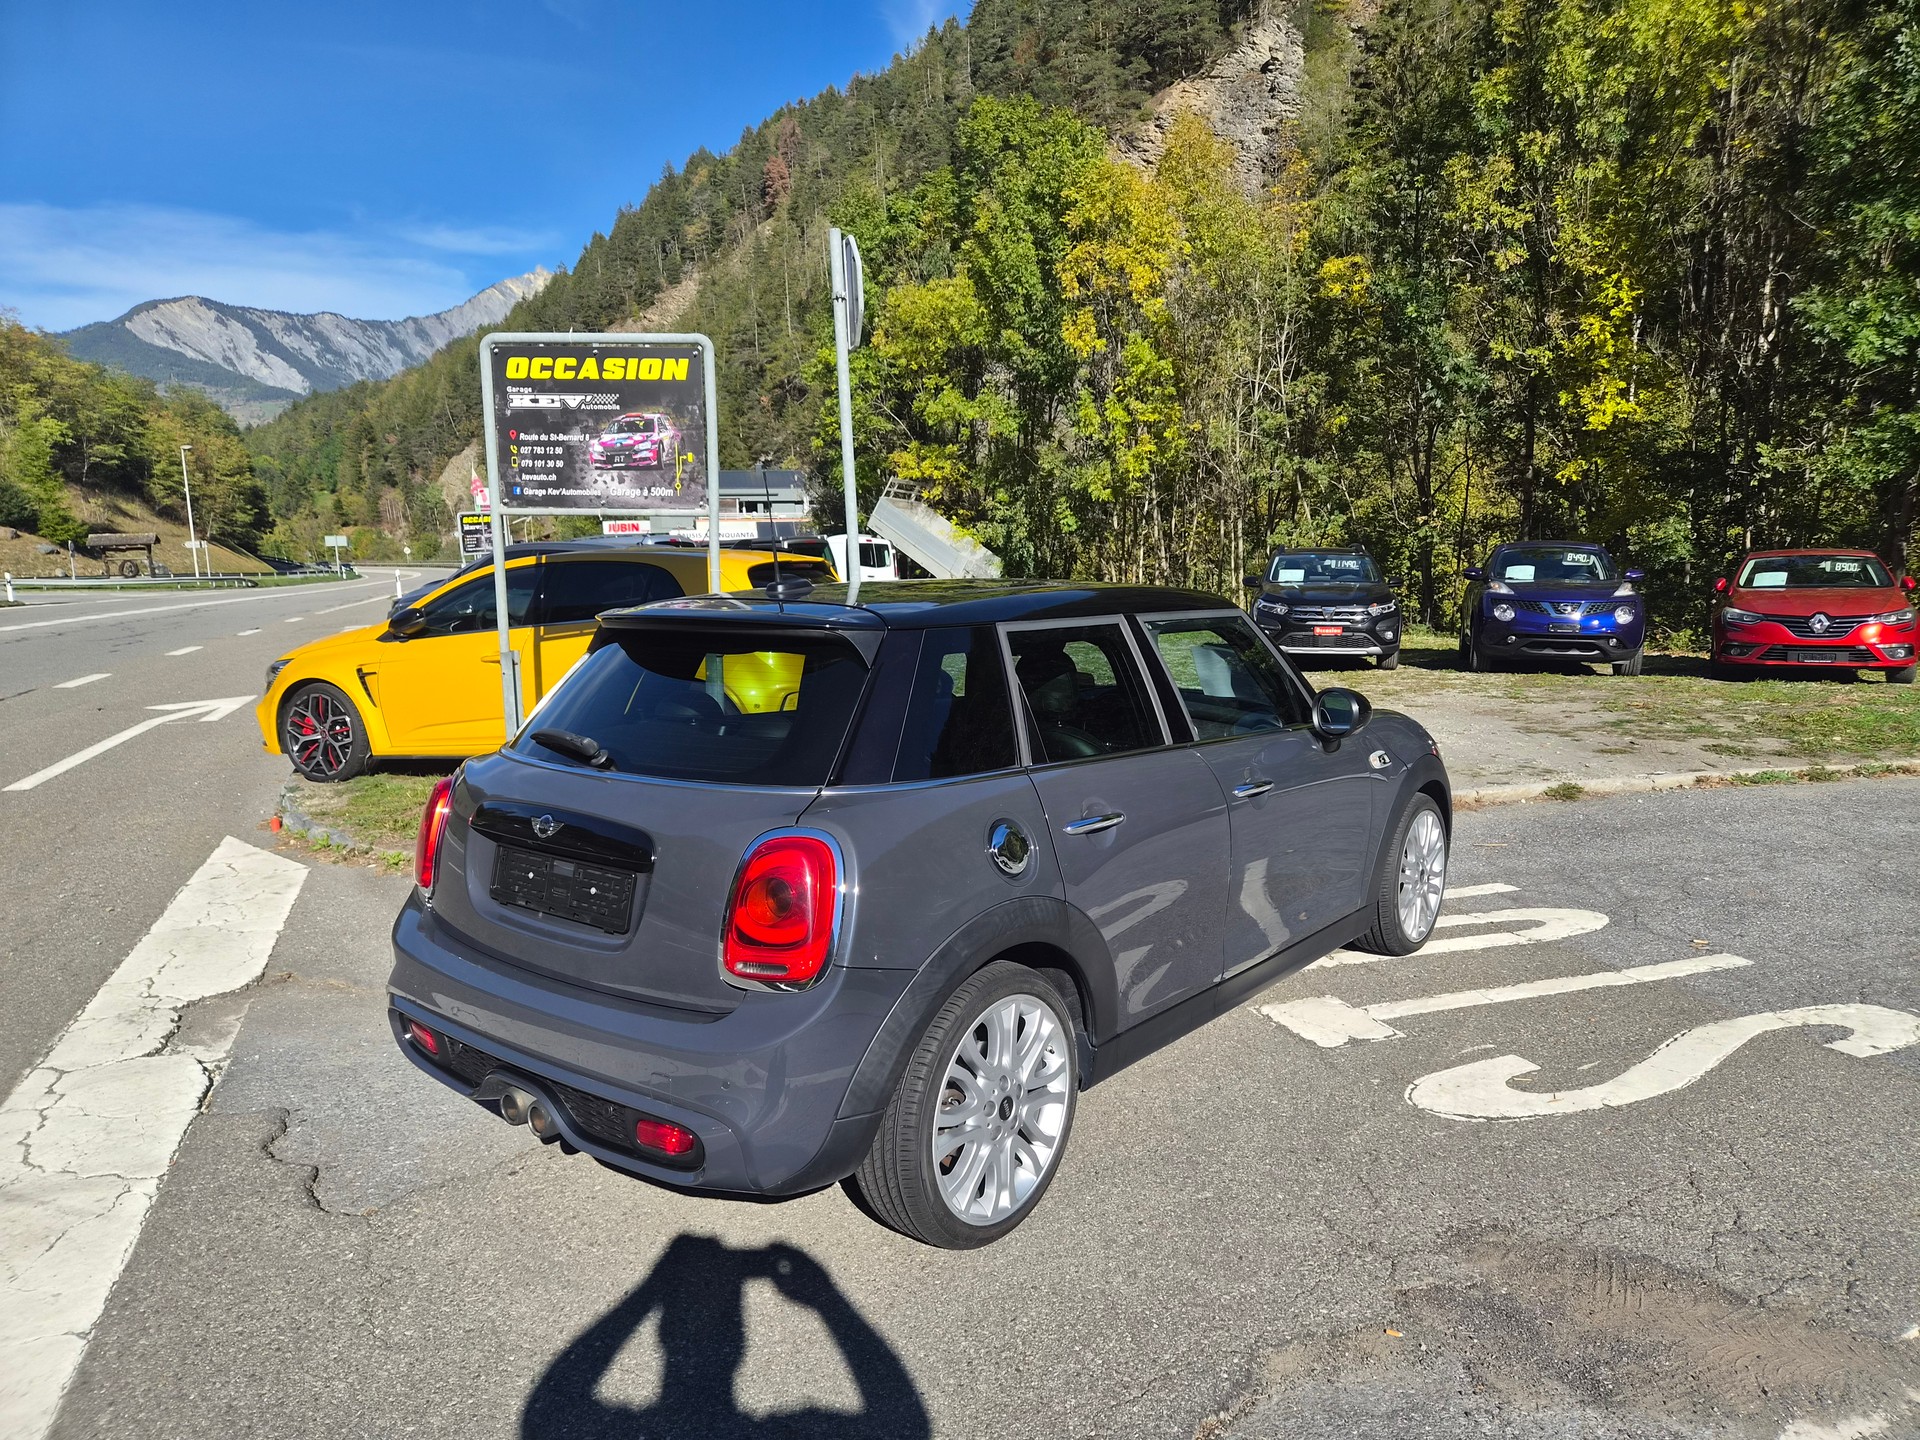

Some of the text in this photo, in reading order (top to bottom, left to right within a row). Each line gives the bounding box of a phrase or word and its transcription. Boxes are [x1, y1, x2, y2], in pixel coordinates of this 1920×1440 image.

[505, 356, 690, 381] OCCASION
[506, 386, 533, 394] Garage
[519, 433, 539, 441] Route
[540, 433, 549, 441] du
[550, 433, 584, 441] St-Bernard
[520, 446, 532, 454] 027
[521, 460, 564, 468] 079 101 30 50
[521, 473, 557, 481] kevauto.ch
[523, 487, 546, 497] Garage
[547, 488, 601, 496] Kev'Automobiles
[610, 487, 674, 498] Garage à 500m
[462, 516, 491, 524] OCCASI
